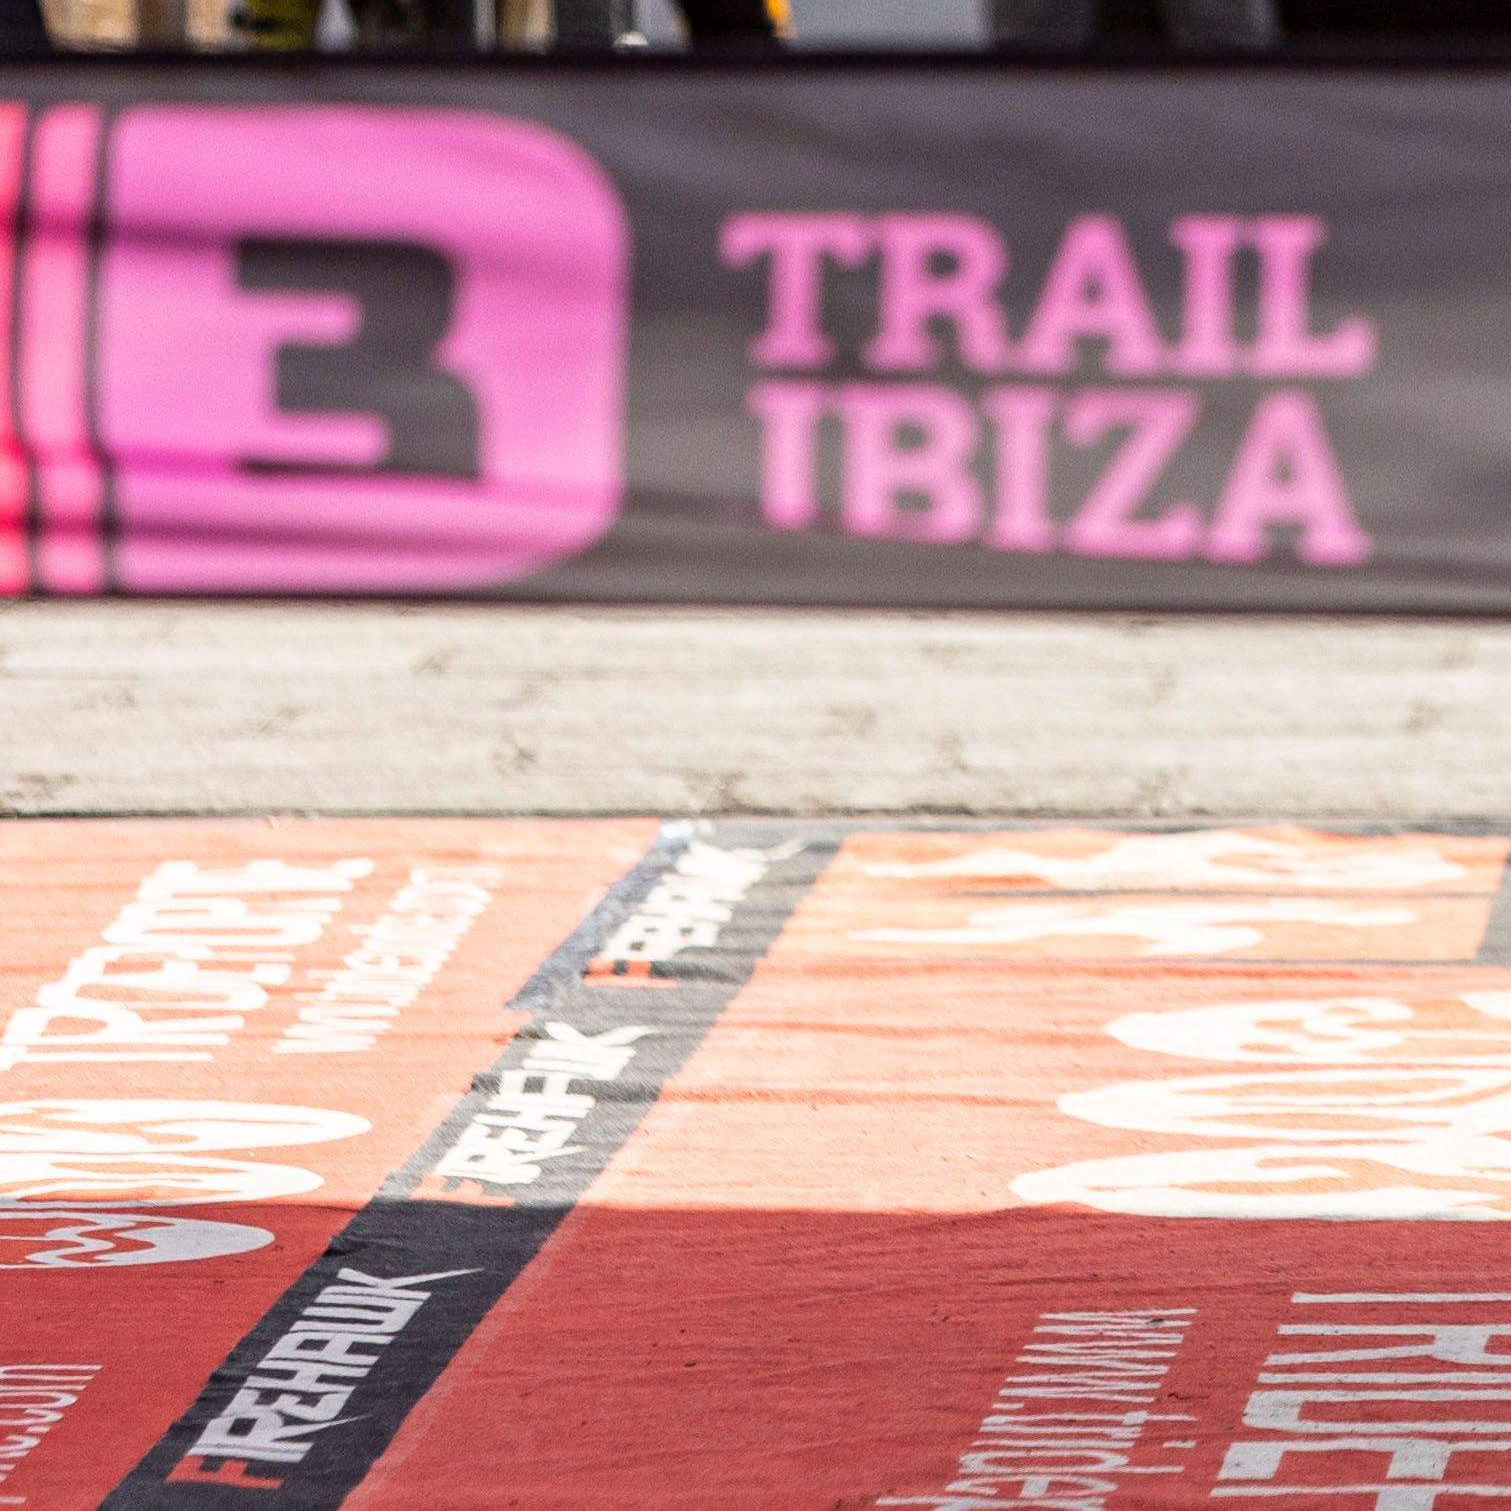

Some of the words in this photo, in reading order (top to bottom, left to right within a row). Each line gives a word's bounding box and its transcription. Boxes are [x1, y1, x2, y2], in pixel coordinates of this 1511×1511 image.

[716, 212, 1375, 378] TRAIL
[745, 380, 1372, 566] IBIZA
[405, 1022, 660, 1208] FIREHAWK
[166, 1267, 486, 1490] FIREHAWK
